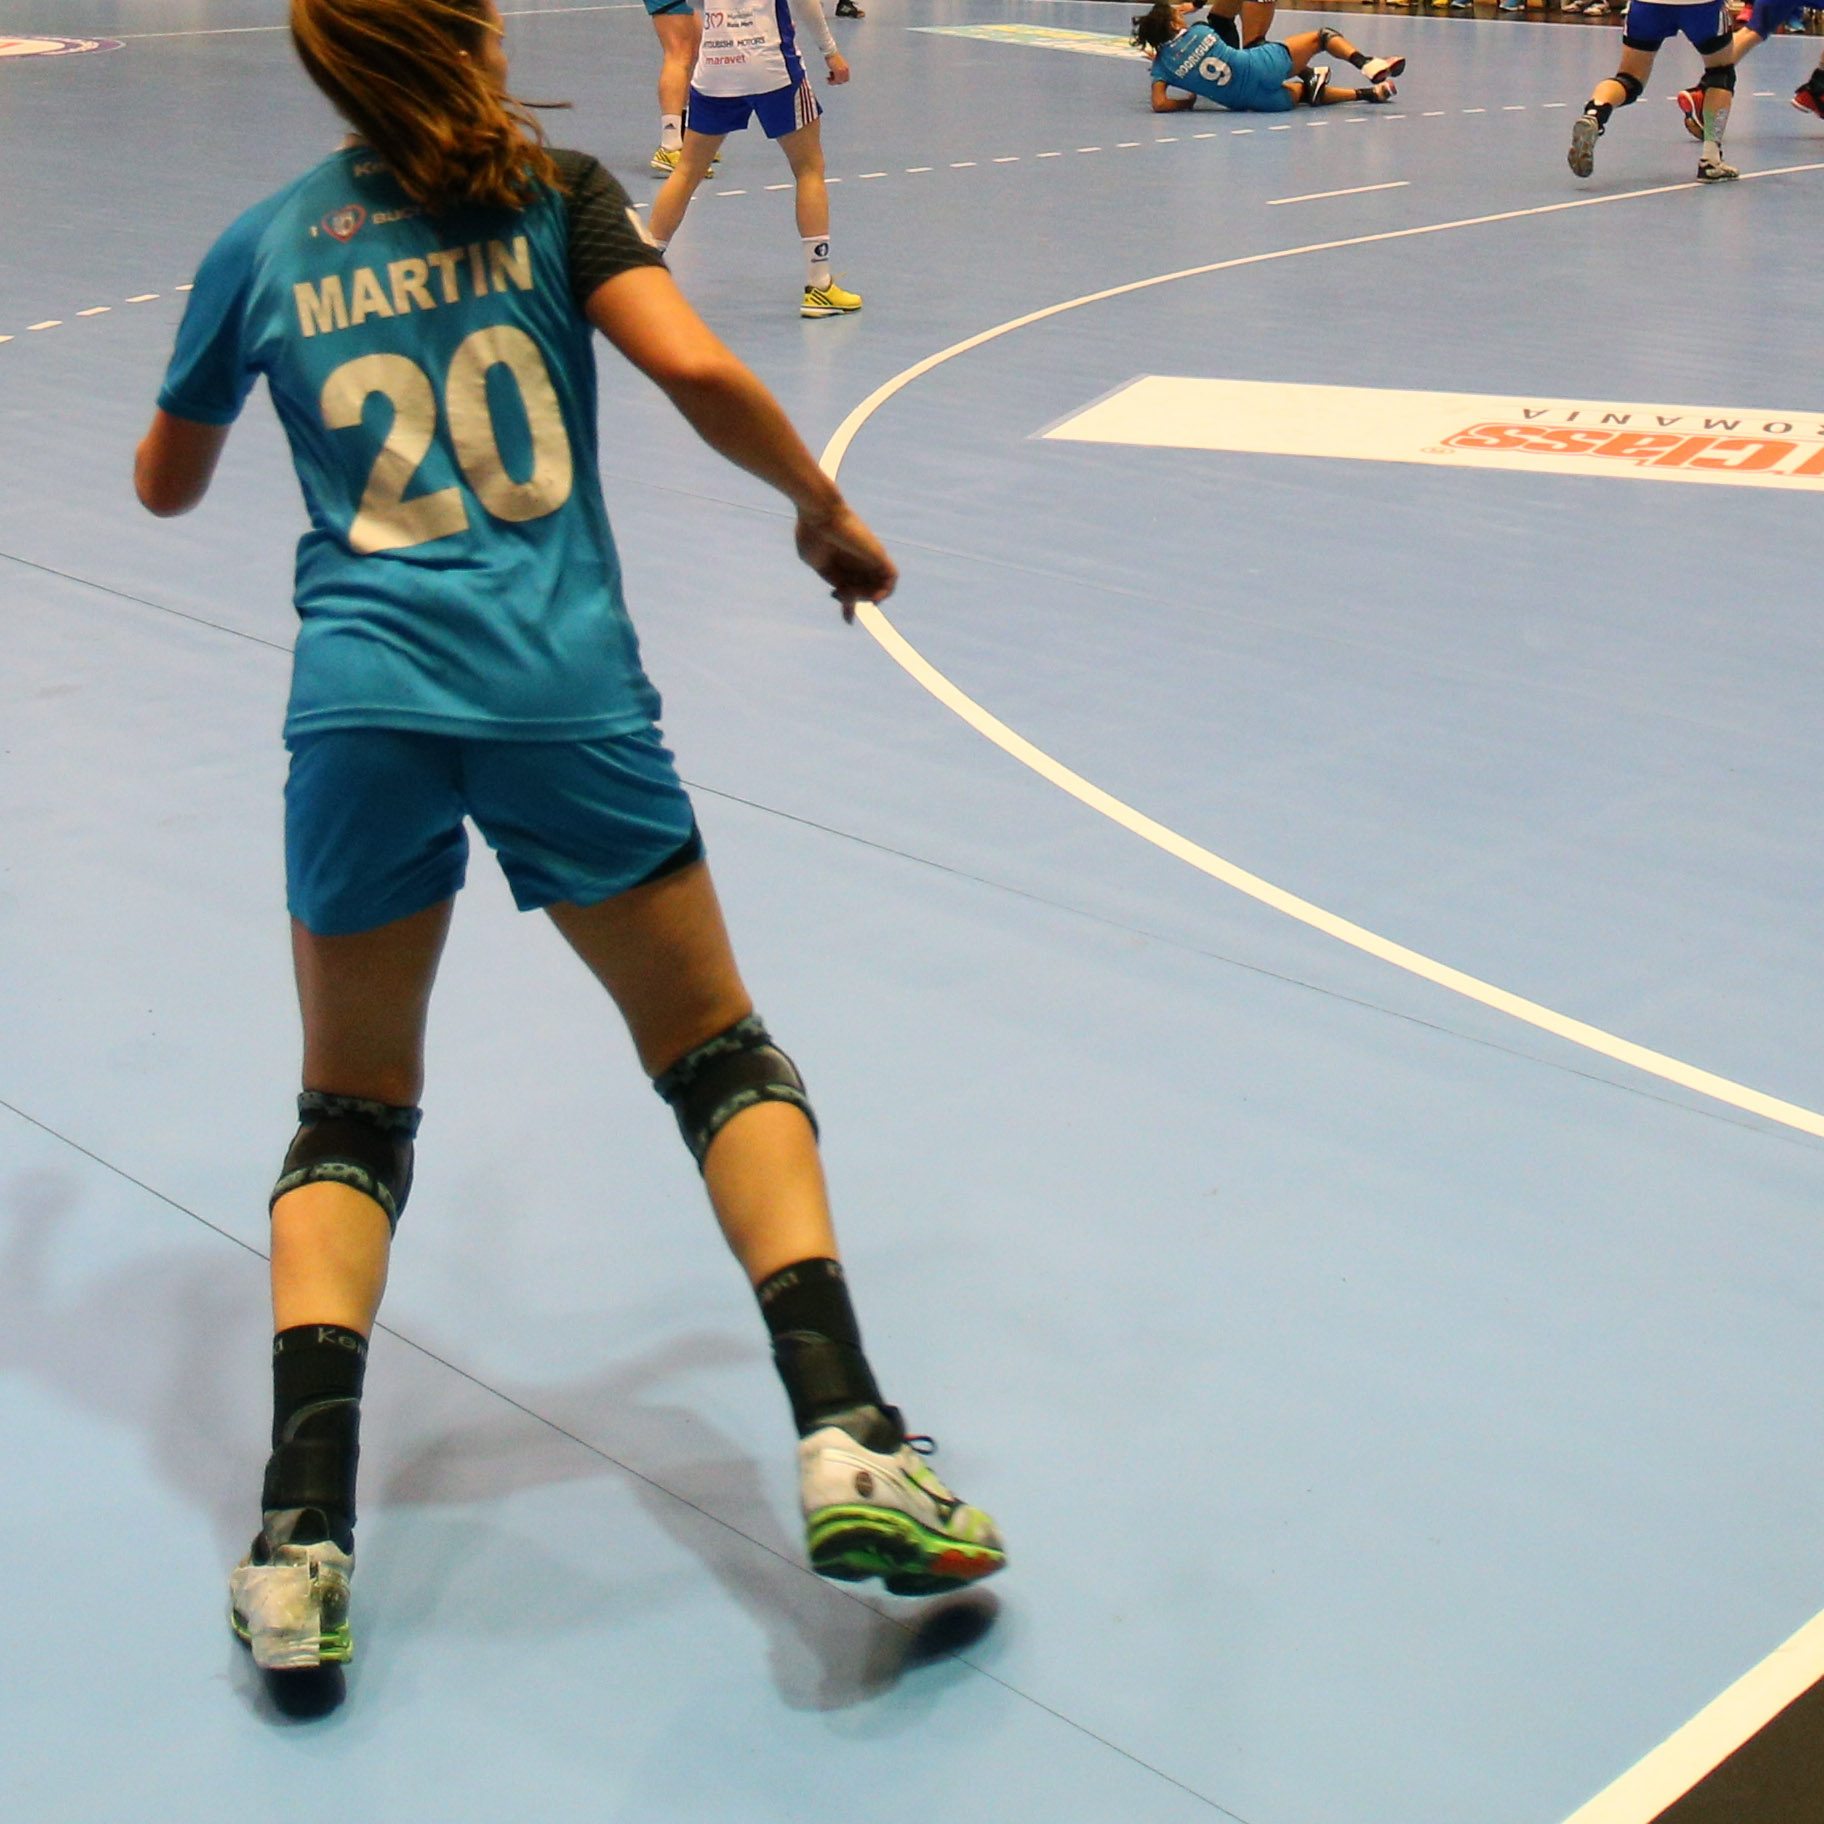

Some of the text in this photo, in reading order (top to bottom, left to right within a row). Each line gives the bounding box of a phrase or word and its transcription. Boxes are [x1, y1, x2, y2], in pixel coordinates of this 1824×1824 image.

[705, 54, 746, 66] maravet
[1199, 56, 1232, 86] 9
[293, 235, 534, 338] MARTIN
[319, 324, 573, 555] 20
